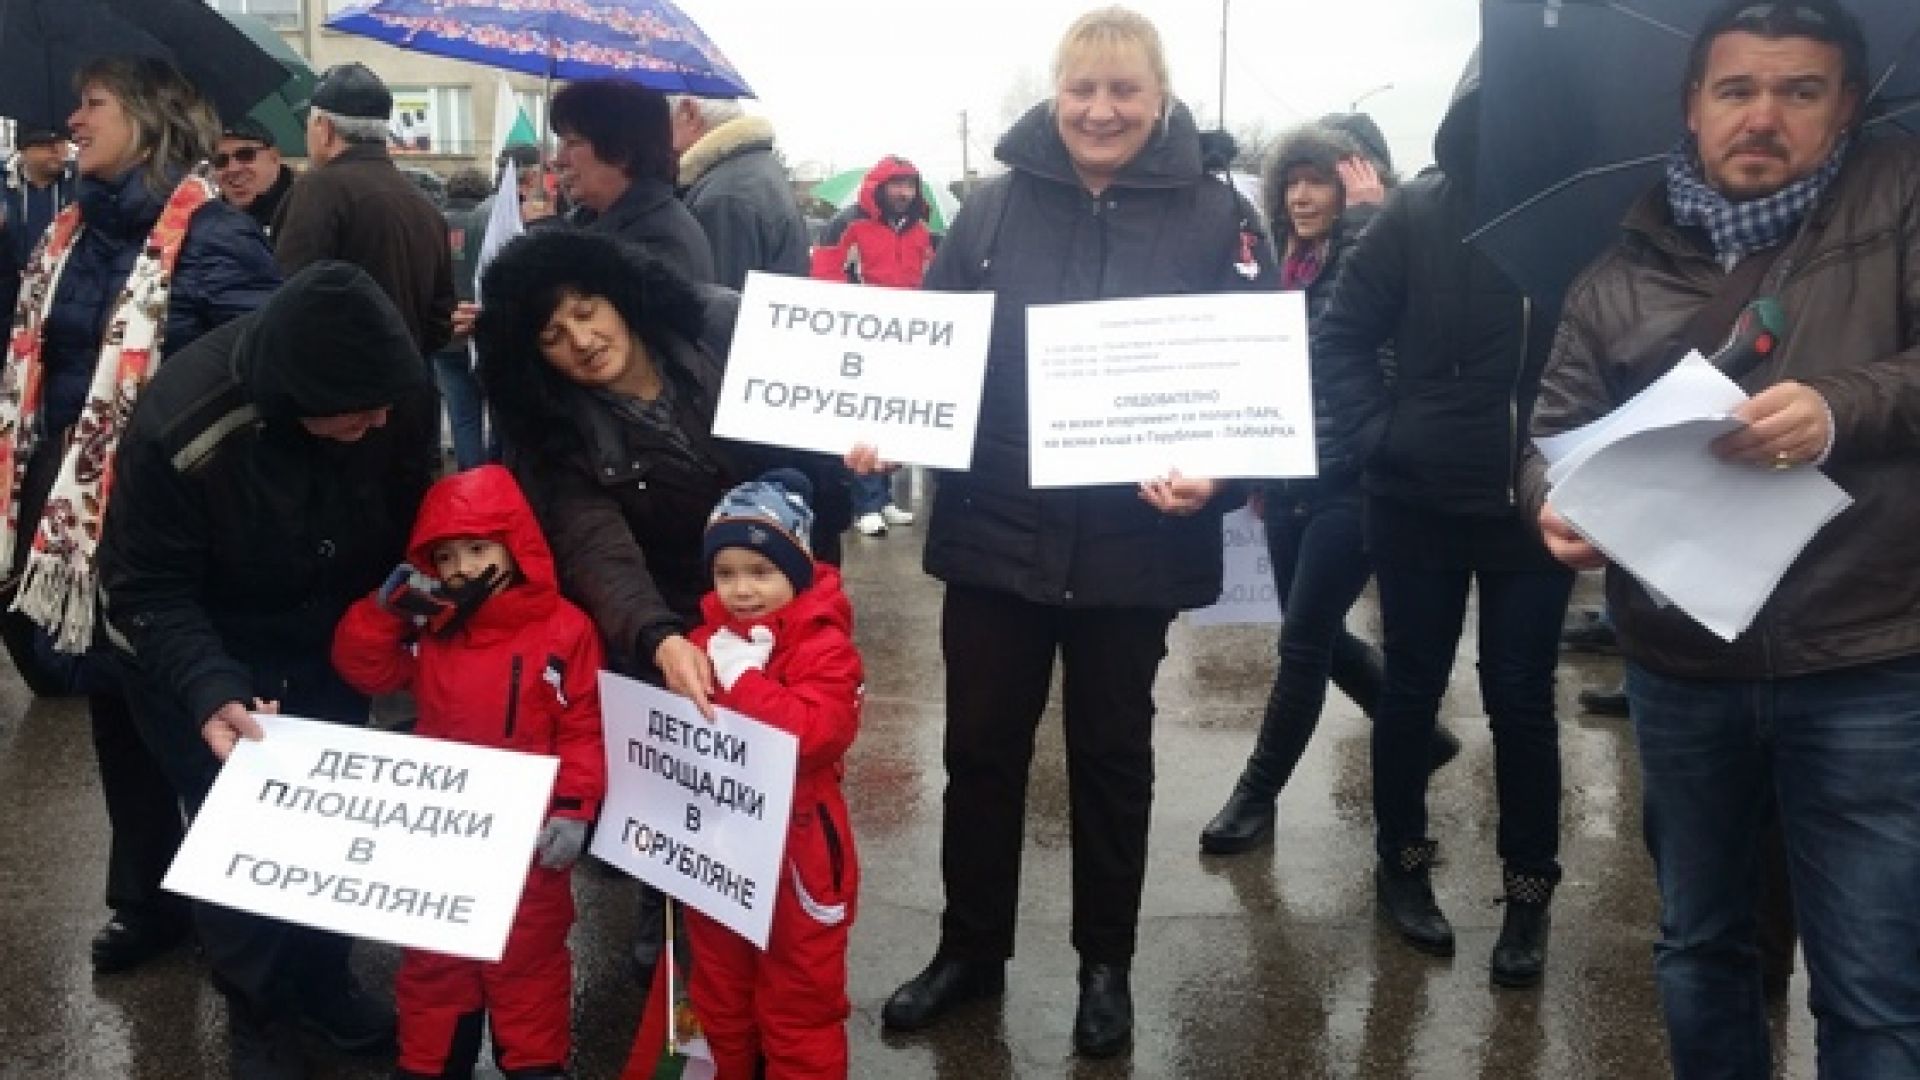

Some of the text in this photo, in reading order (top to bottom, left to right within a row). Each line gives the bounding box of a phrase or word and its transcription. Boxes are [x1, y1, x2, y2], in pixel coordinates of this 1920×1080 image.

[769, 302, 953, 345] ТРОТОАРИ
[840, 352, 864, 378] В
[744, 379, 957, 429] ГОРУБЛЯНЕ
[1113, 390, 1220, 408] СЛЕДОВАТЕЛНО
[649, 707, 748, 767] ДЕТСКИ
[308, 748, 468, 794] ДЕТСКИ
[628, 738, 765, 820] ПЛОЩАДКИ
[258, 778, 493, 838] ПЛОЩАДКИ
[685, 803, 701, 833] В
[346, 837, 376, 864] В
[622, 817, 756, 909] ГОРУБЛЯНЕ
[225, 853, 476, 924] ГОРУБЛЯНЕ
